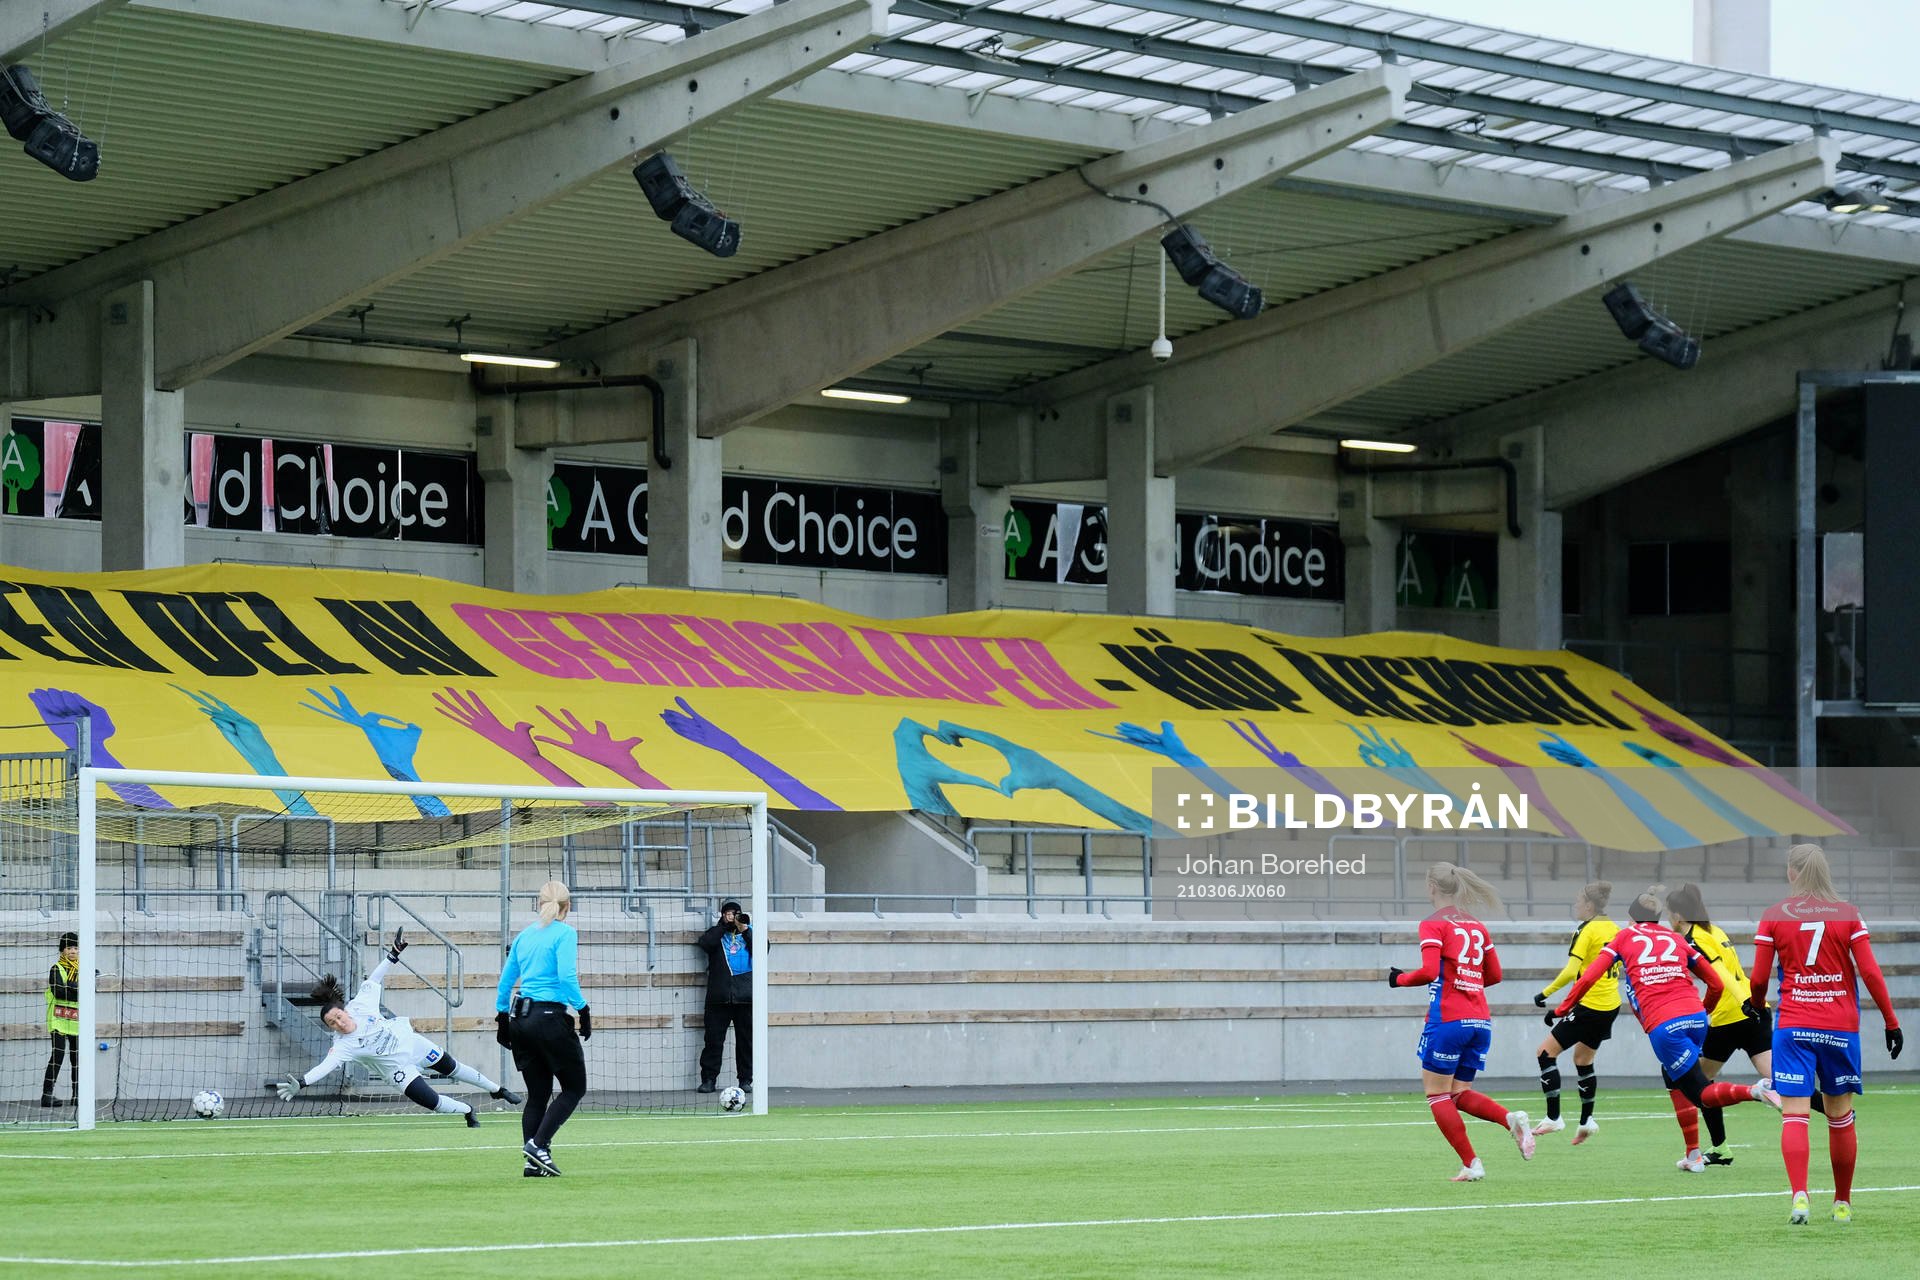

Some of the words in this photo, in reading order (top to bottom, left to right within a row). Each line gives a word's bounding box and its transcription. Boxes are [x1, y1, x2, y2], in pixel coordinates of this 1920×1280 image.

[276, 453, 448, 528] Choice
[581, 480, 616, 543] A
[764, 491, 918, 559] Choice
[1194, 523, 1326, 588] Choice
[107, 589, 373, 676] DEL
[450, 602, 1122, 710] GEMENSKAPEN
[1454, 927, 1484, 966] 23
[1632, 935, 1680, 965] 22
[1799, 921, 1826, 966] 7
[1791, 988, 1847, 998] Motorcentrum
[1792, 1031, 1834, 1040] TRANSPORT
[1811, 1037, 1849, 1049] SEKTIONEN
